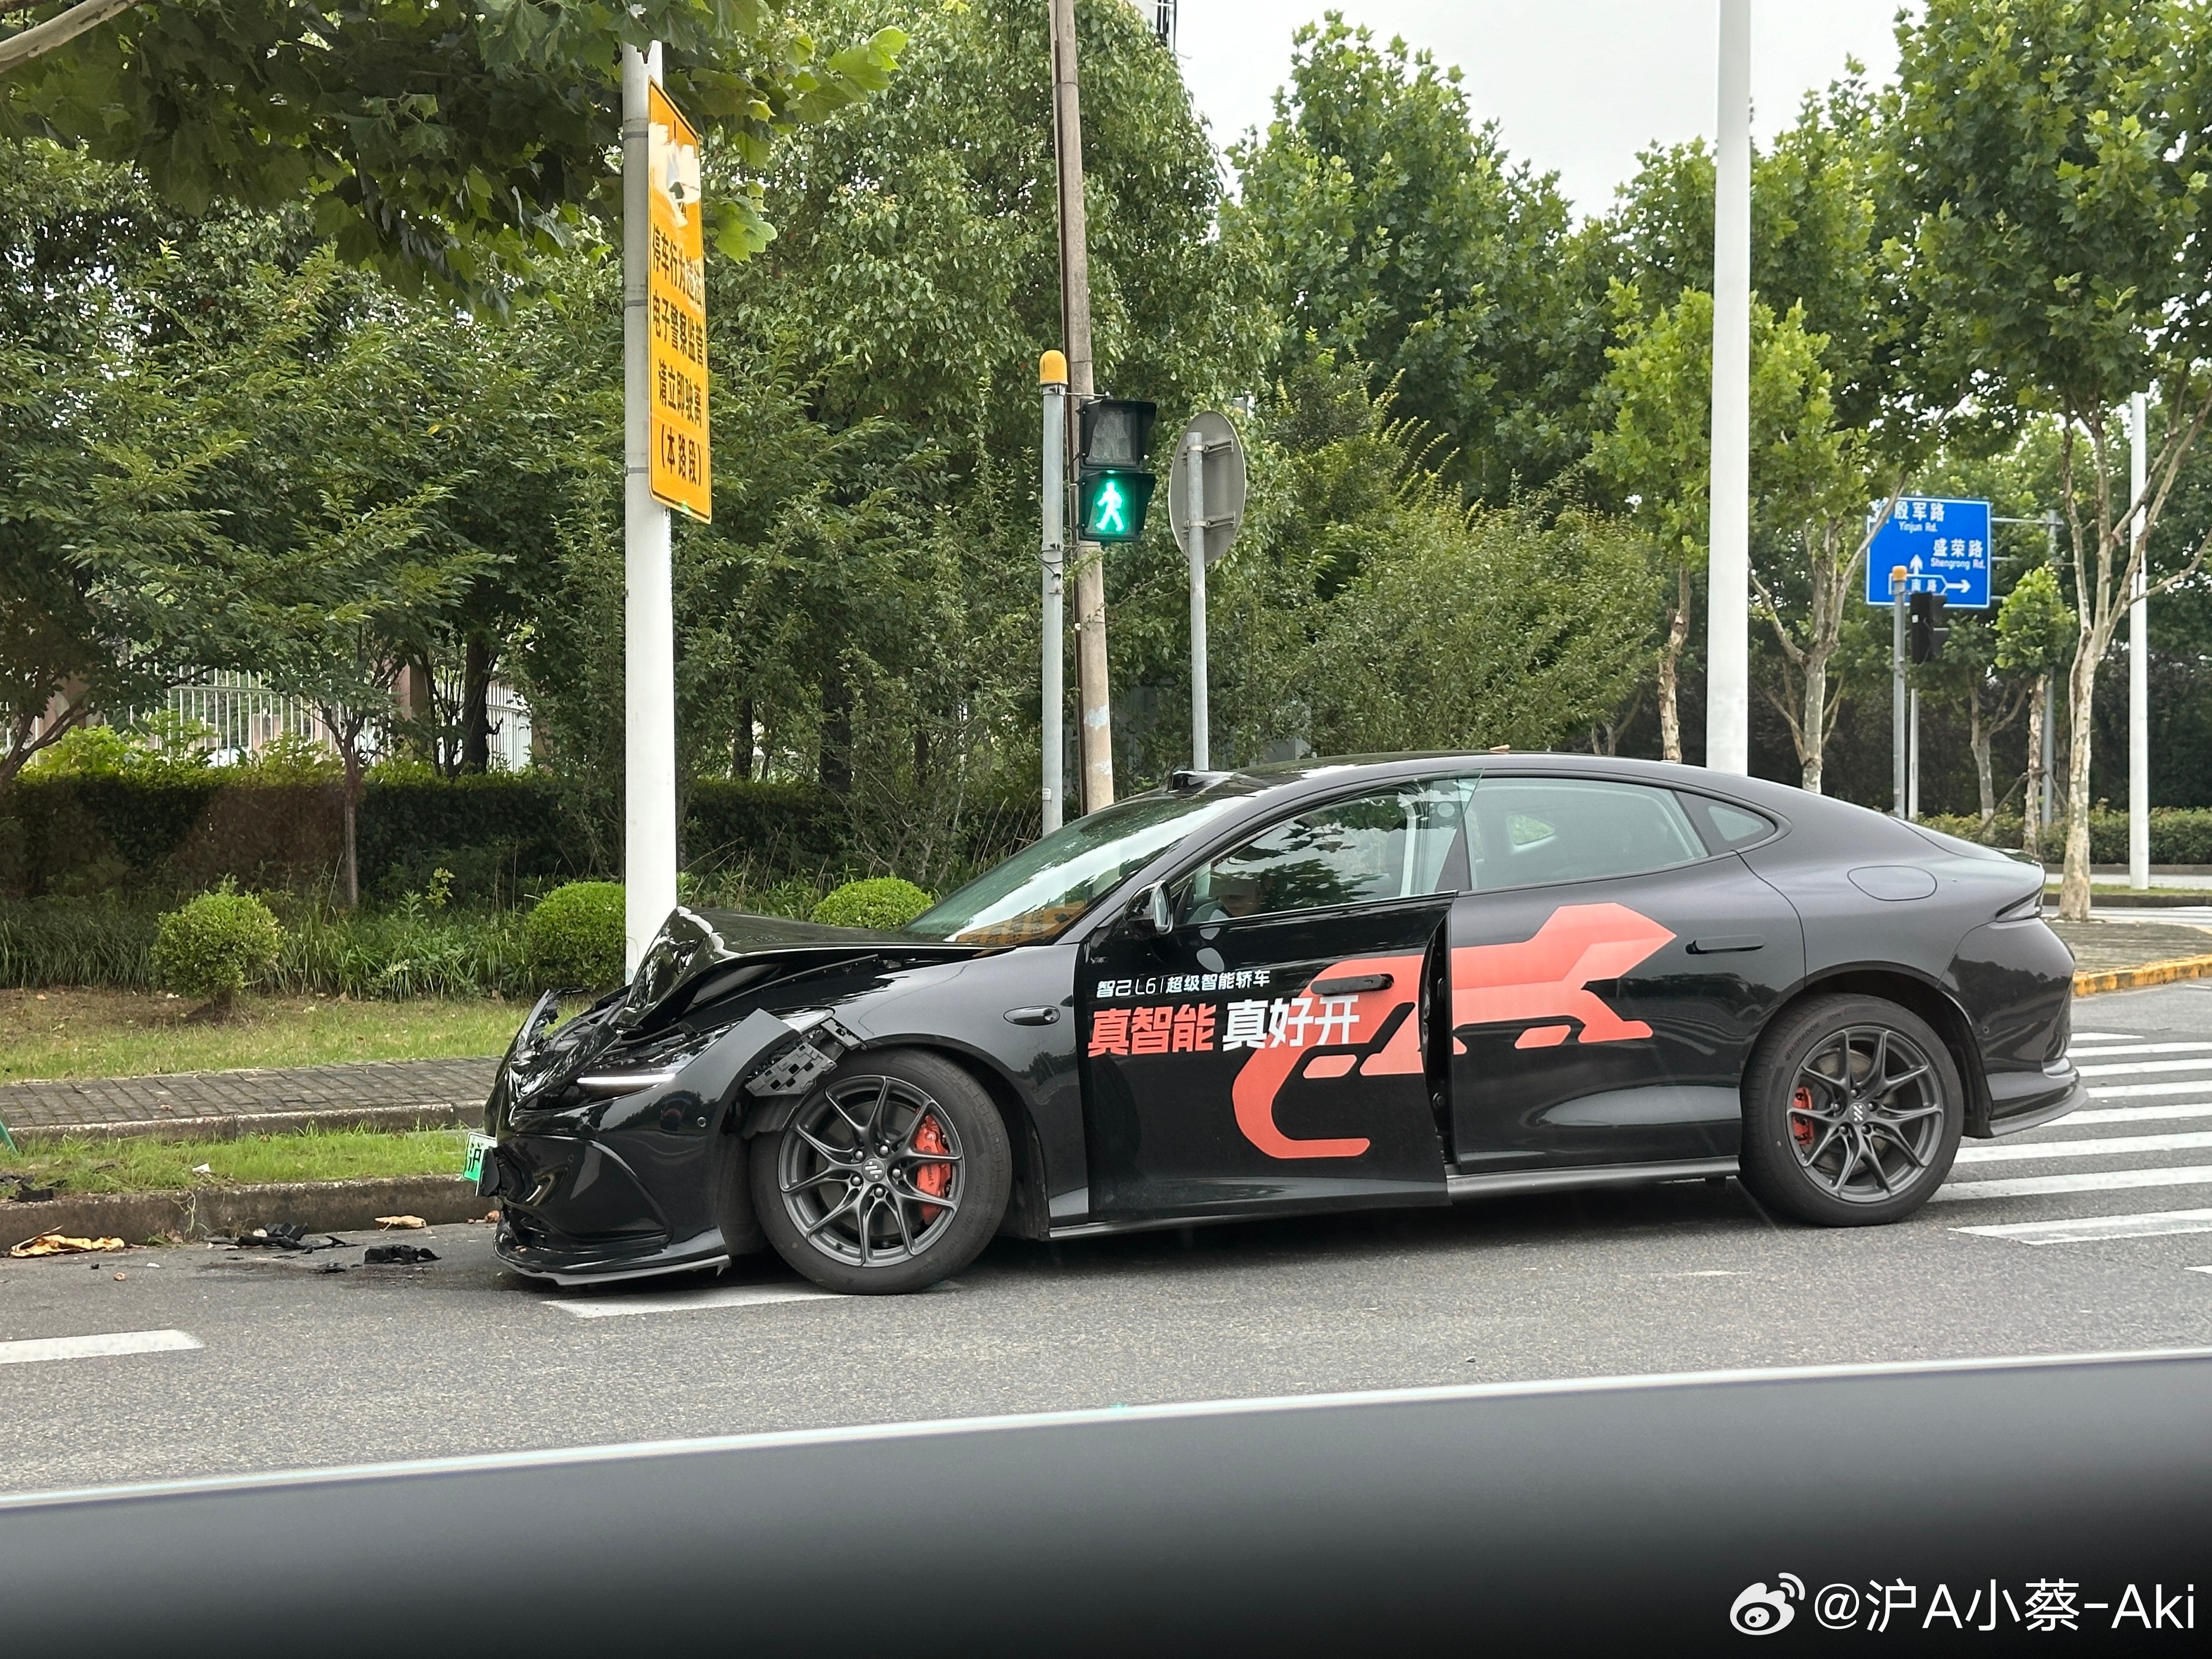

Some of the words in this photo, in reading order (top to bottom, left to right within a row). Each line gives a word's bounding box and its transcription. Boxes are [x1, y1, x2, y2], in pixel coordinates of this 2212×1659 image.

[653, 289, 703, 368] 电子警察监管
[659, 358, 701, 428] 请立即驶离
[1894, 501, 1944, 522] 殷军路
[1925, 522, 1938, 532] Rd.
[1933, 538, 1983, 558] 盛荣路
[1931, 557, 1970, 570] Shengrong
[1973, 559, 1986, 569] Rd.
[1088, 1003, 1216, 1057] 真智能
[1222, 995, 1360, 1051] 真好开
[467, 1143, 482, 1173] 沪
